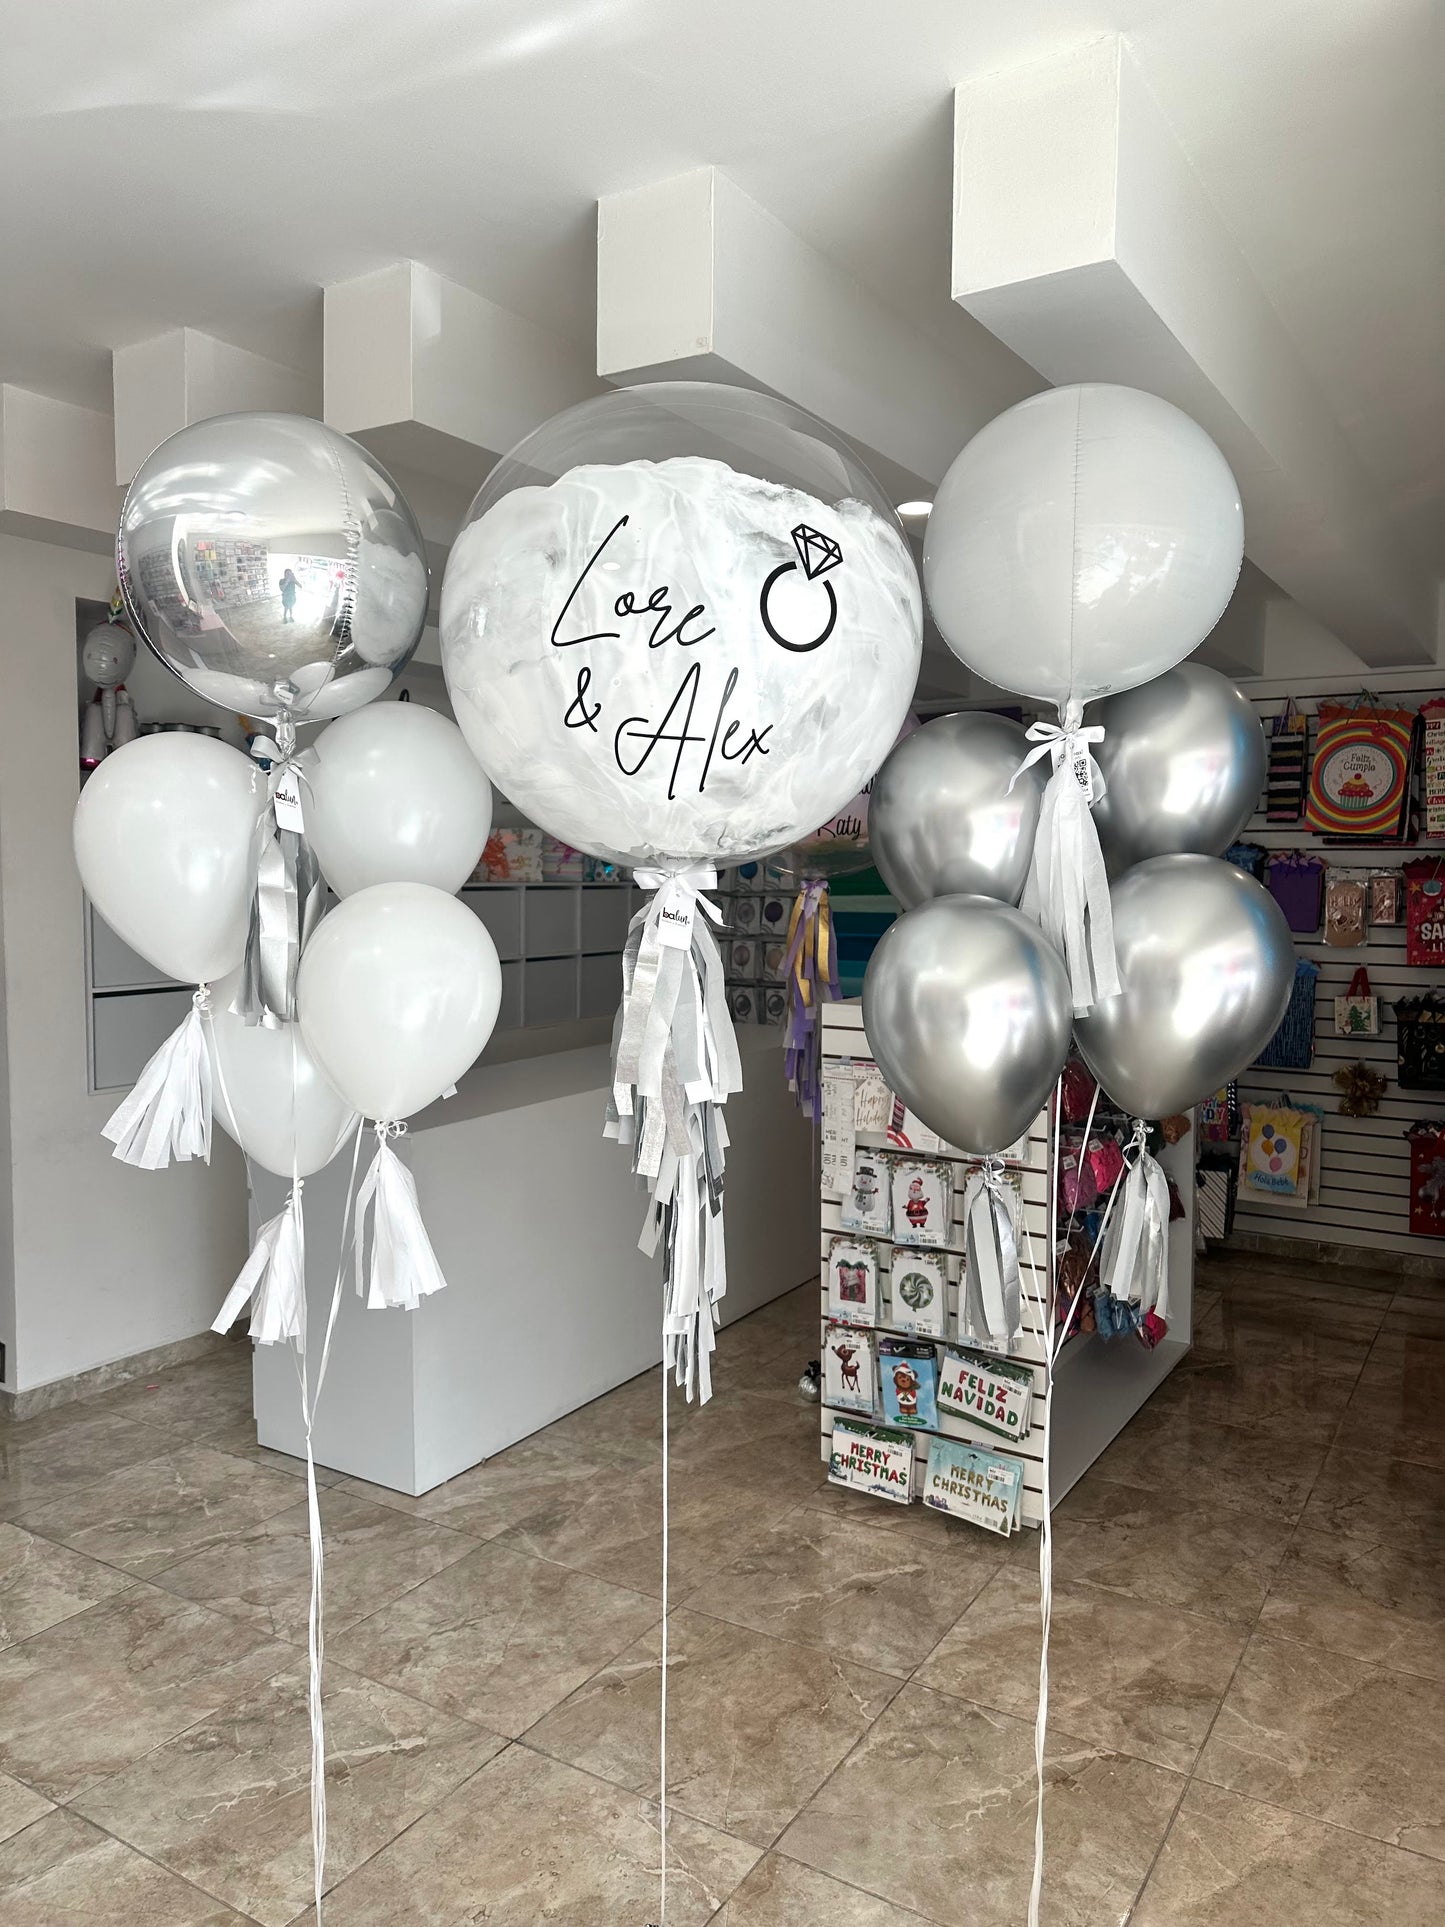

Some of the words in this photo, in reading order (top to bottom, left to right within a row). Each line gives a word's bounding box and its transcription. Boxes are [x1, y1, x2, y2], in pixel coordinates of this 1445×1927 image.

[551, 514, 716, 648] Lore
[564, 667, 602, 732] &
[614, 662, 774, 800] Alex
[818, 816, 861, 841] Katy
[1254, 1173, 1271, 1185] Hola
[941, 1381, 1019, 1426] NAVIDAD
[959, 1370, 1008, 1404] FELIZ
[832, 1452, 908, 1486] CHRISTMAS
[851, 1442, 891, 1466] MERRY
[933, 1474, 1008, 1513] CHRISTMAS
[950, 1464, 994, 1492] MERRY
